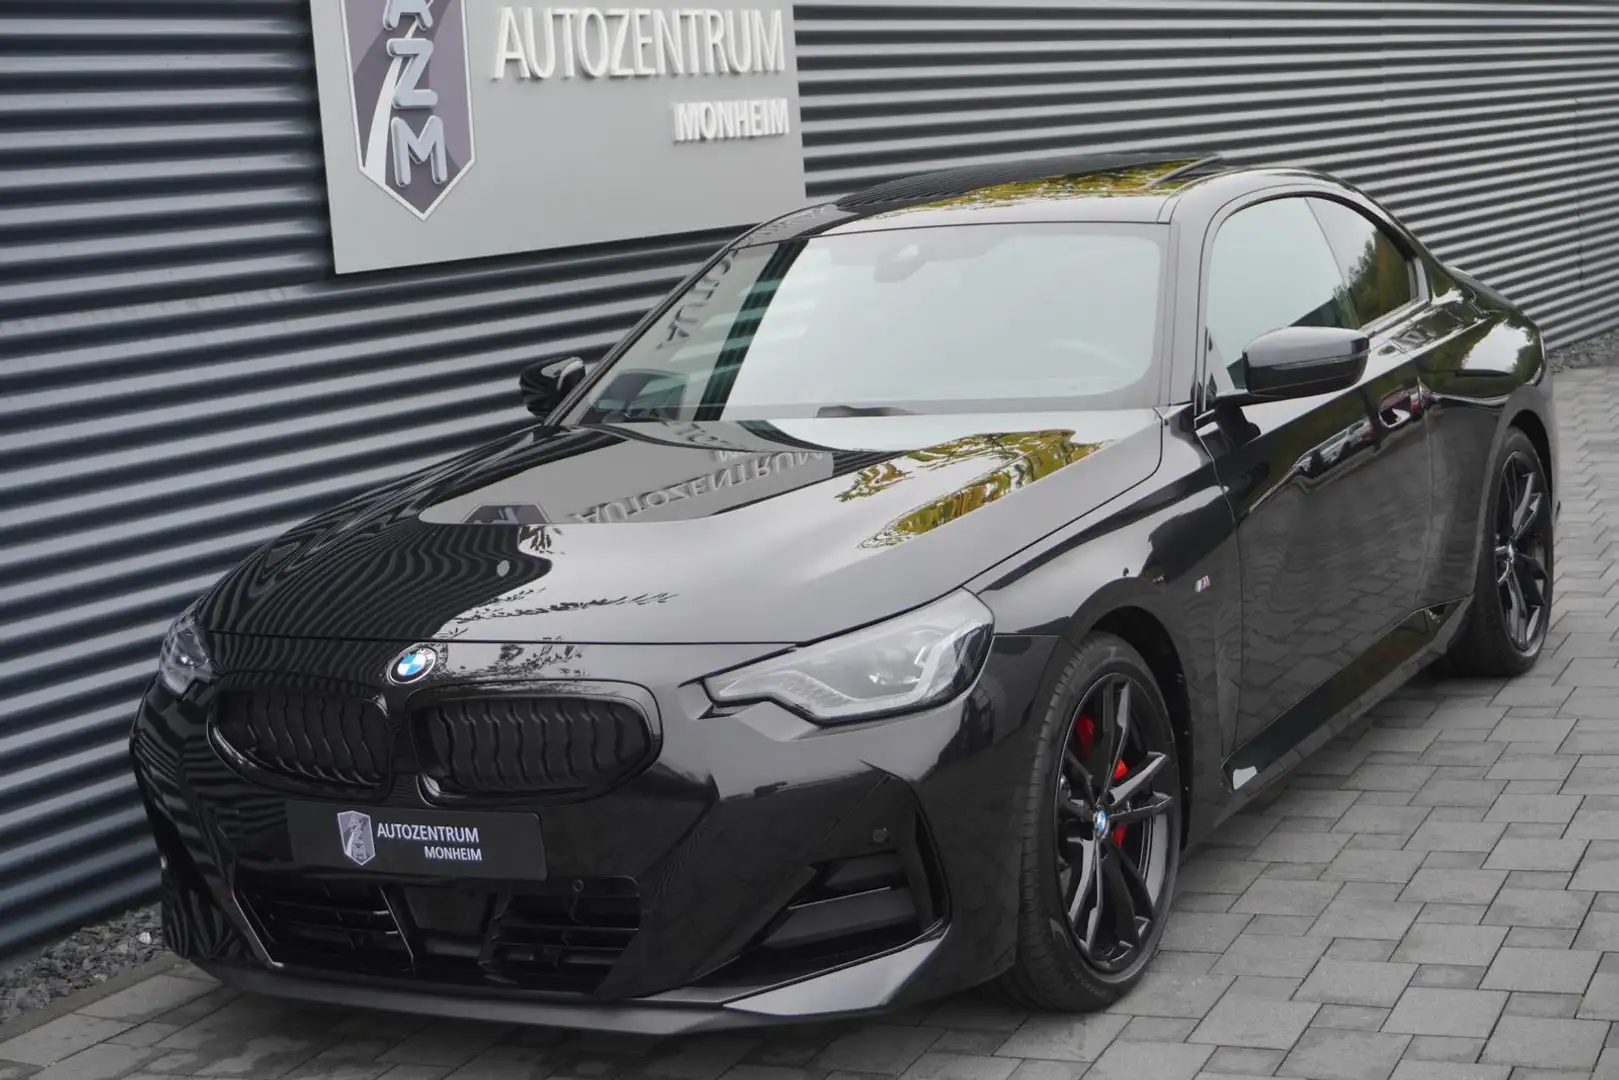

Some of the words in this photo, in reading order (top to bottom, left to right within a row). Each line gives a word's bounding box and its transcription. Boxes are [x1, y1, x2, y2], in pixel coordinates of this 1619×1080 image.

[492, 7, 786, 80] AUTOZENTRUM
[674, 98, 789, 142] MONHEIM
[377, 822, 479, 843] AUTOZENTRUM
[424, 846, 482, 861] MONHEIM
